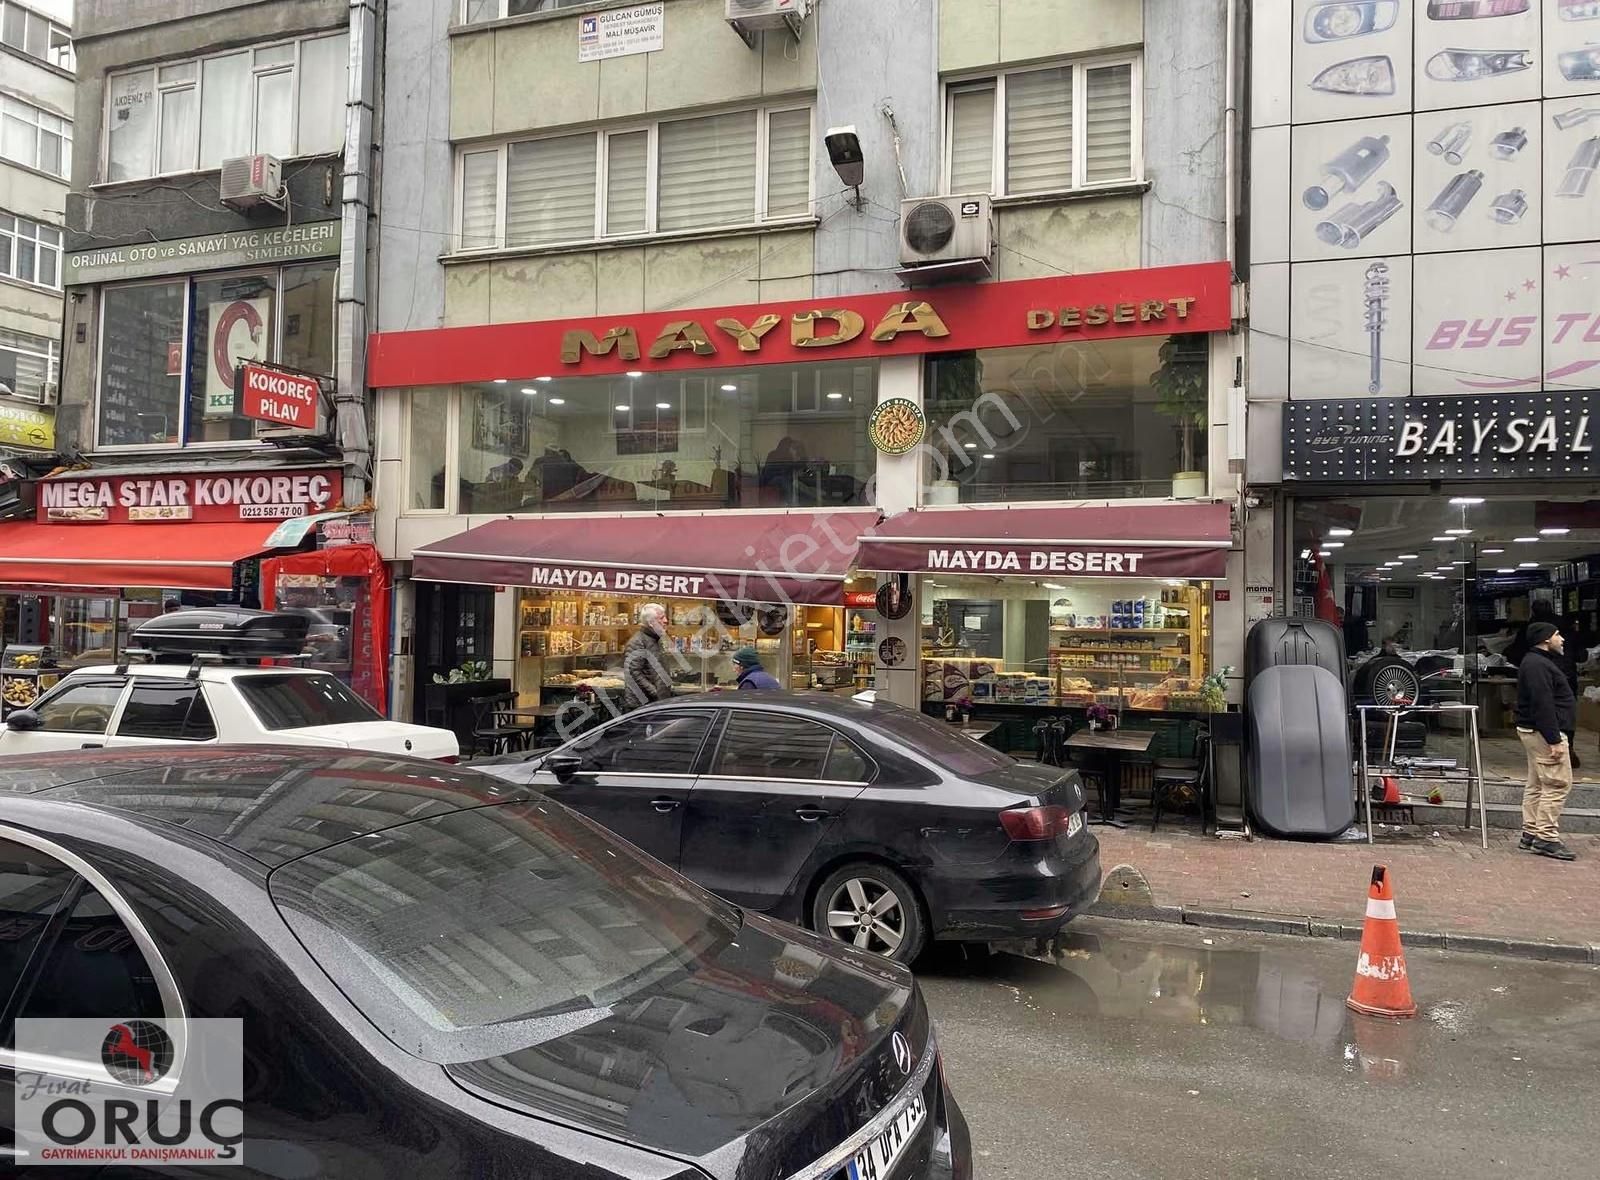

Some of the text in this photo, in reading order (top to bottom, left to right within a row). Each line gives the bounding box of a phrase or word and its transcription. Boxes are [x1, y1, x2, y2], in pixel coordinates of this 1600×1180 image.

[71, 250, 126, 268] ORJİNAL
[129, 247, 158, 263] OTO
[160, 247, 175, 257] ve
[178, 237, 228, 256] SANAYİ
[1027, 297, 1196, 329] DESERT
[560, 301, 951, 364] MAYDA
[1425, 315, 1538, 350] BYS
[249, 371, 313, 405] KOKOREÇ
[1312, 436, 1340, 445] BYS
[1395, 416, 1593, 457] BAYSAL
[42, 475, 332, 511] MEGA STAR KOKOREÇ
[242, 505, 303, 517] 0212 587 47 00
[927, 549, 1144, 573] MAYDA DESERT
[531, 567, 704, 594] MAYDA DESERT
